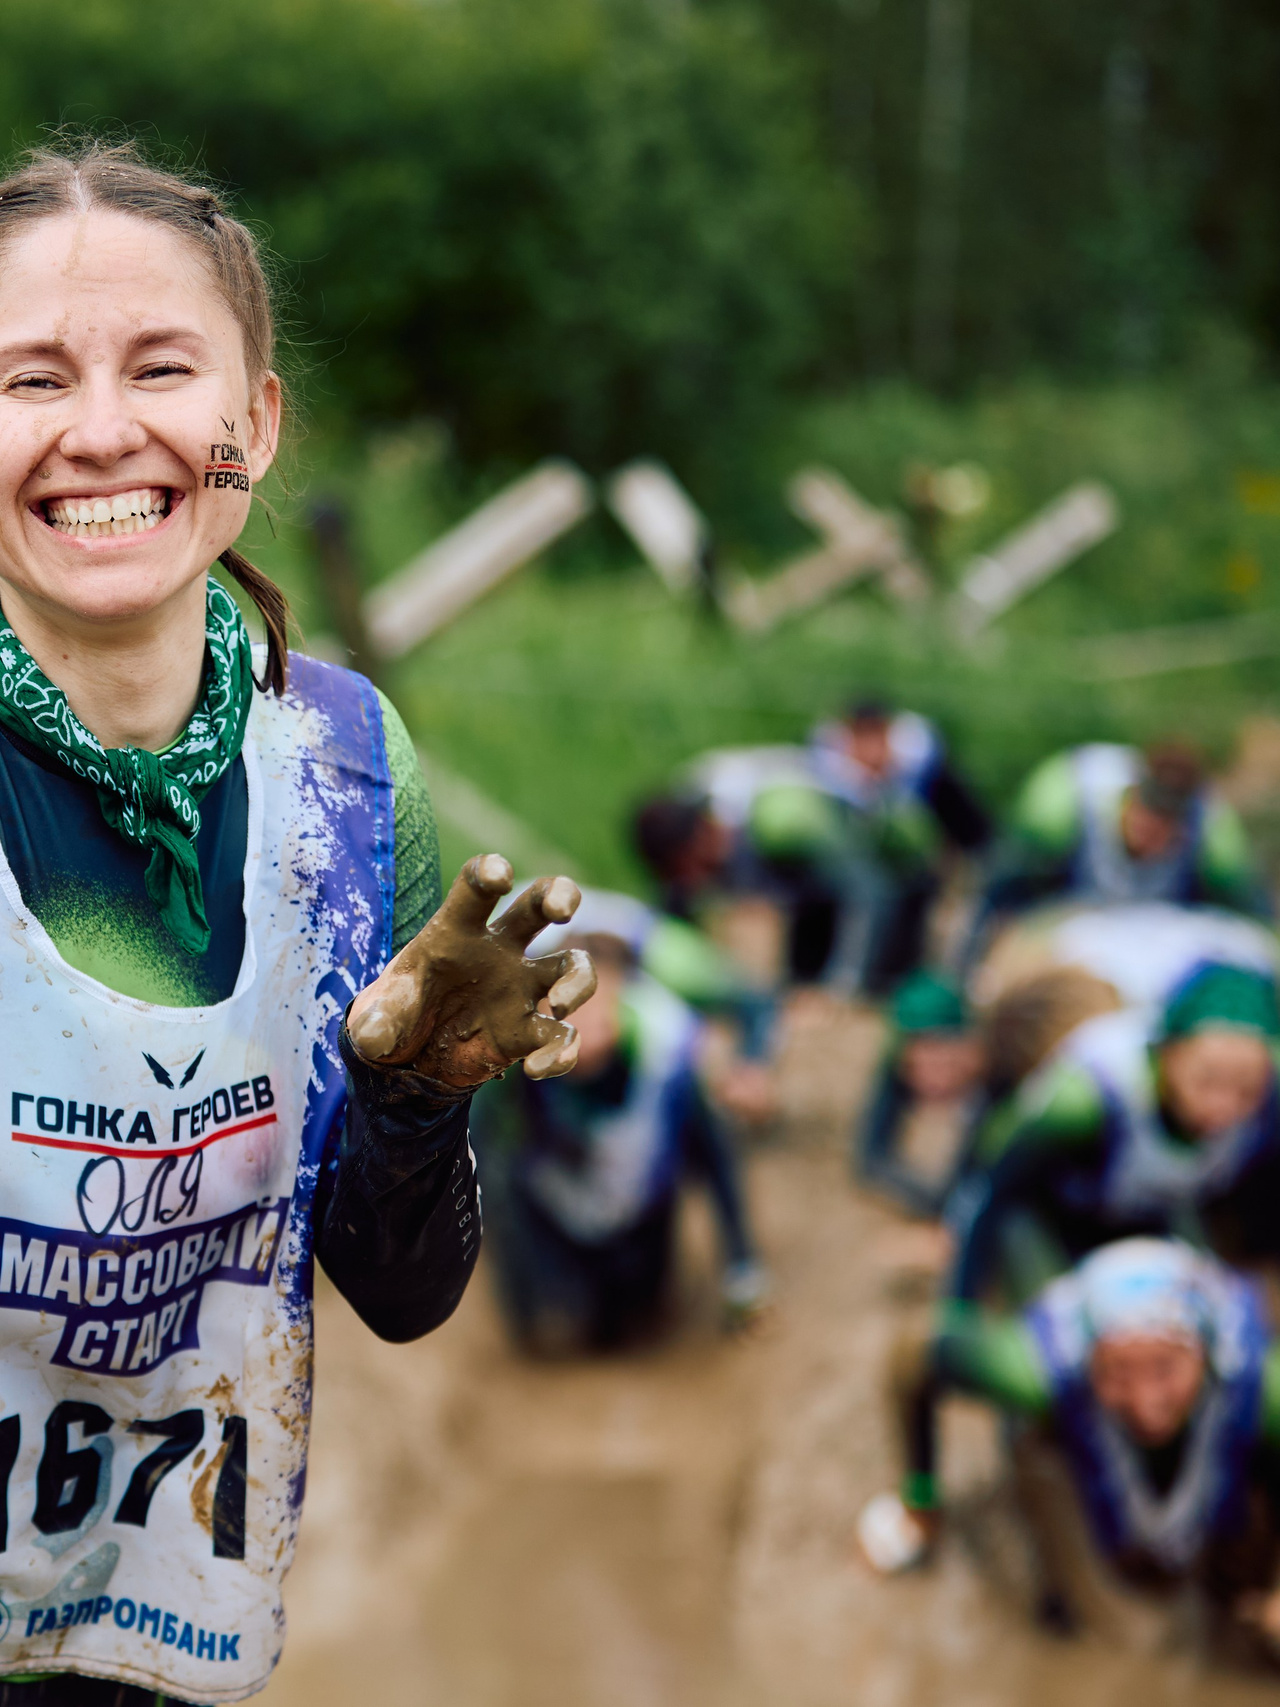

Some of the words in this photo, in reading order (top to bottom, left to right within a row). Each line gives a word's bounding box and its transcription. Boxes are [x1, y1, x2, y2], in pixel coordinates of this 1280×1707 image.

[210, 443, 246, 465] ГОНКА
[11, 1091, 157, 1145] ГОНКА
[171, 1074, 276, 1143] ГЕРОЕВ
[66, 1289, 197, 1372] СТАРТ
[24, 1595, 242, 1662] ГАЗПРОМБАНК
